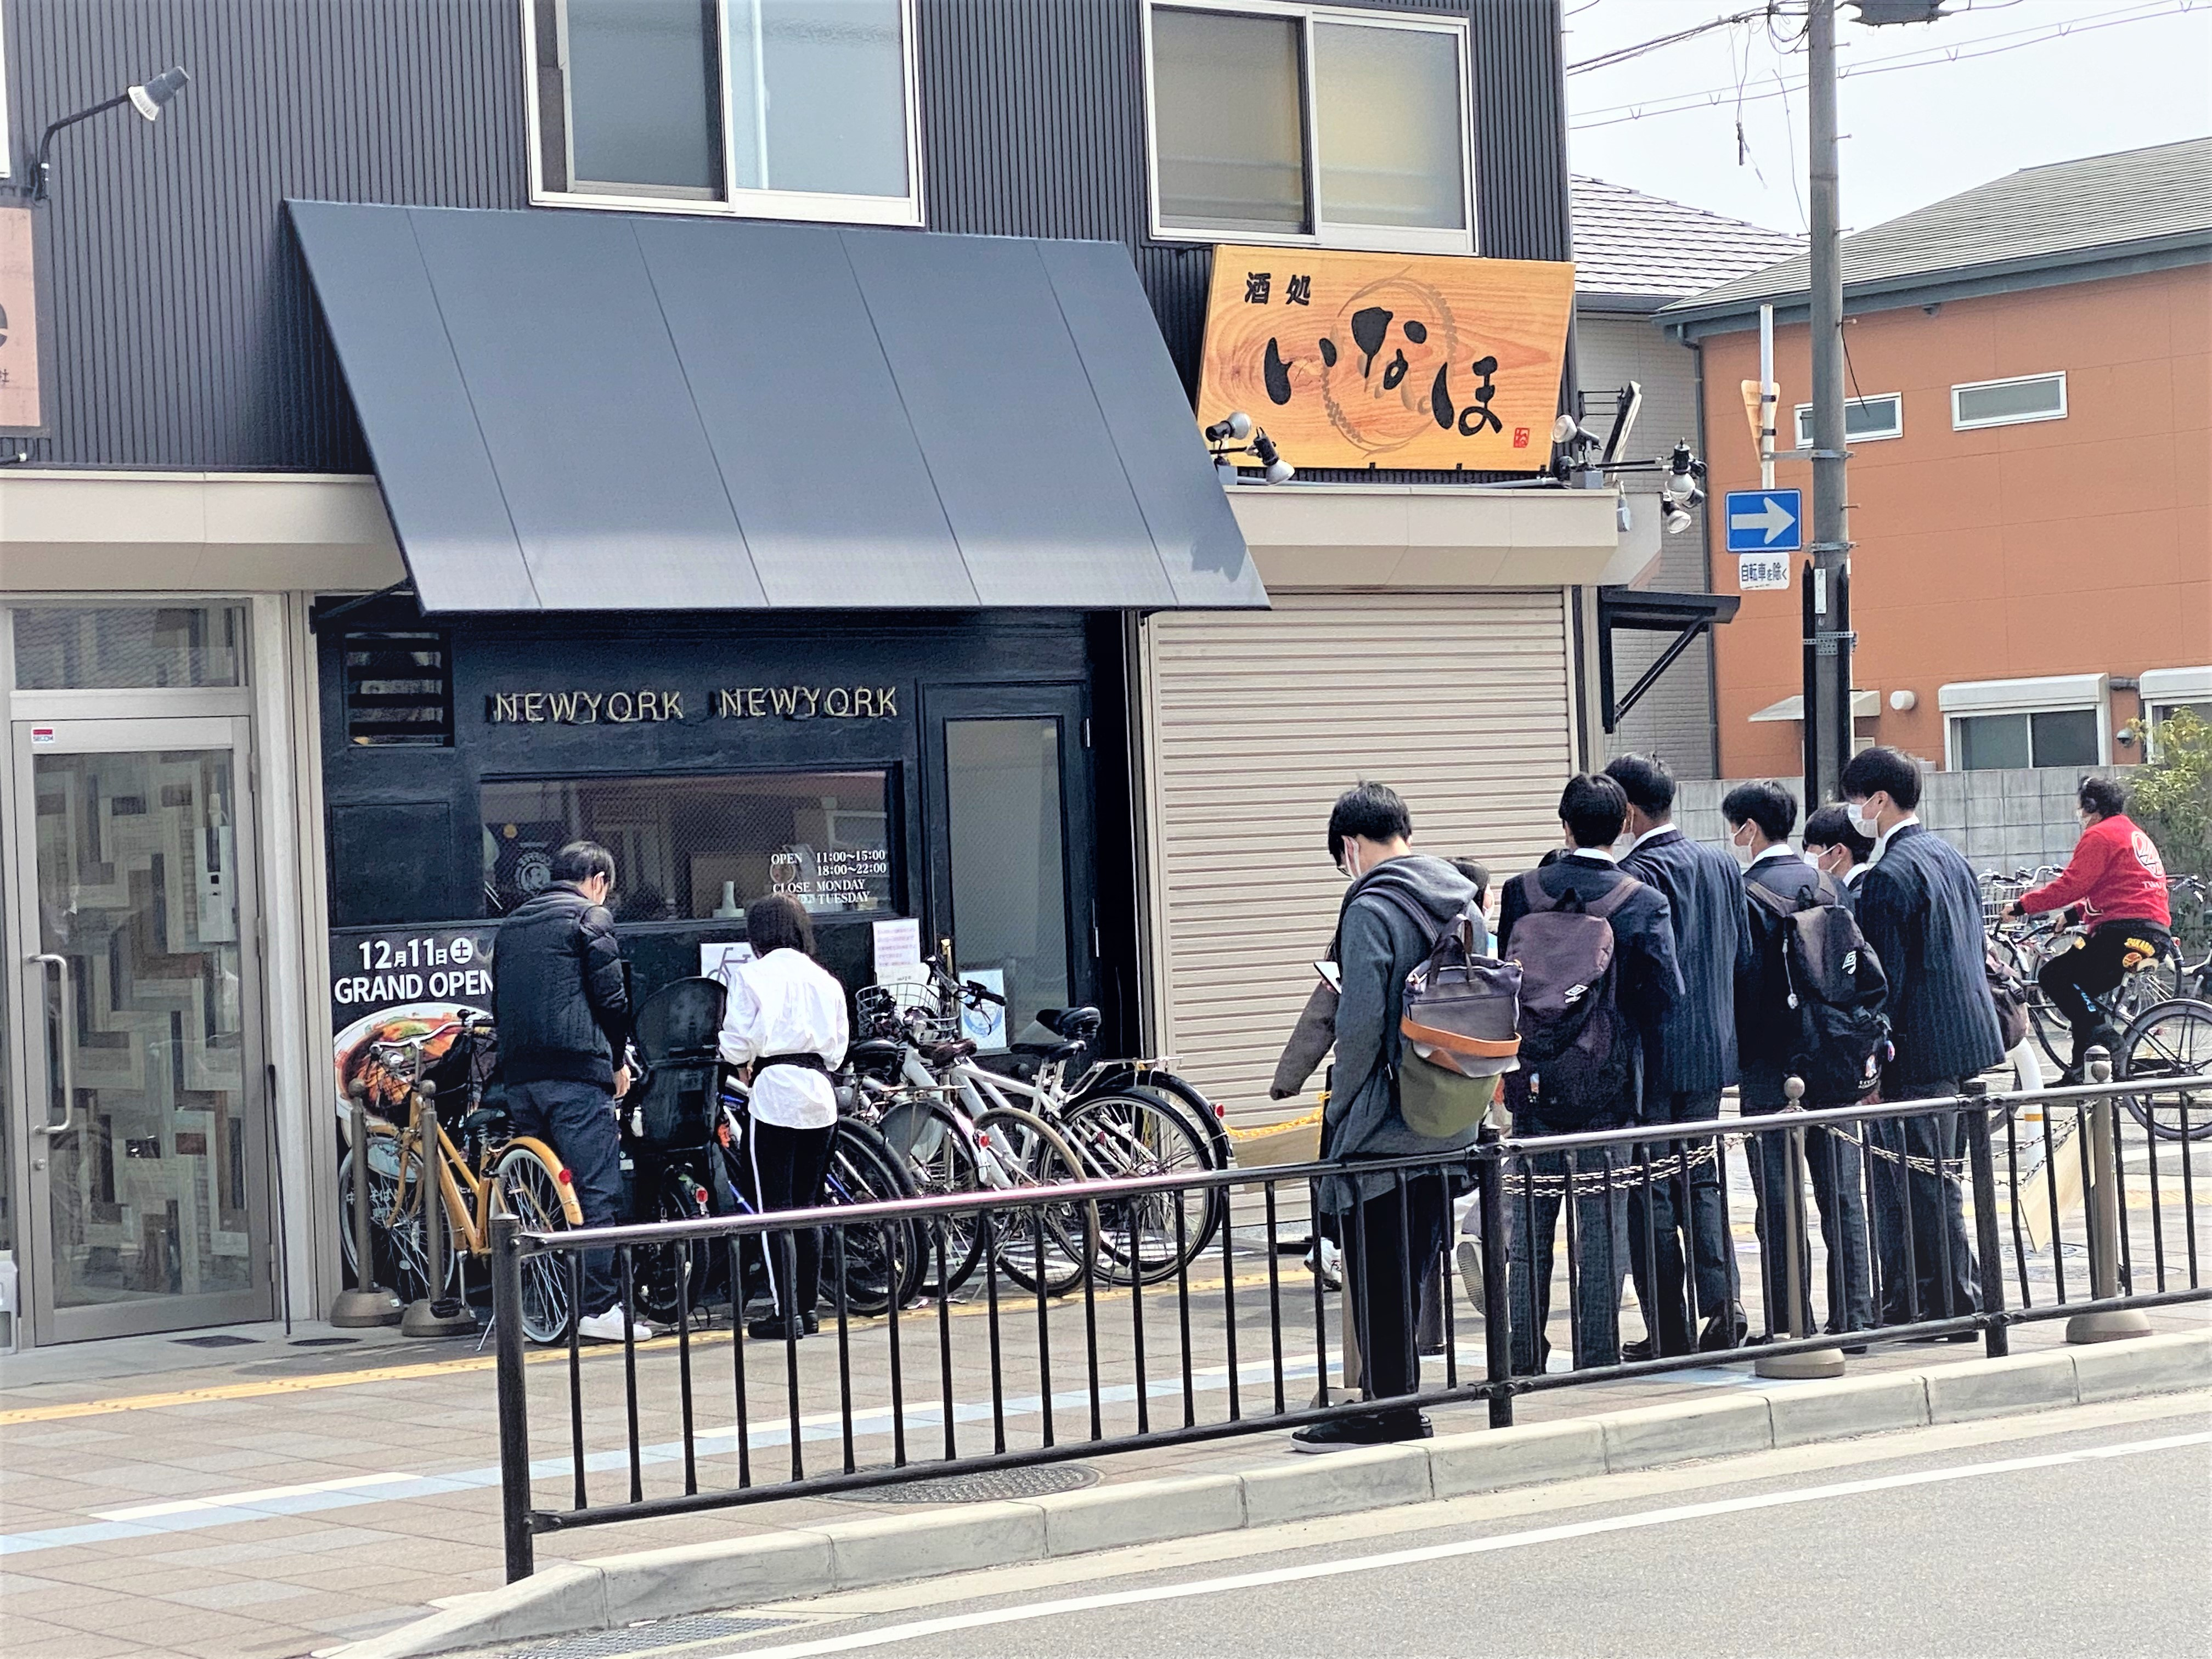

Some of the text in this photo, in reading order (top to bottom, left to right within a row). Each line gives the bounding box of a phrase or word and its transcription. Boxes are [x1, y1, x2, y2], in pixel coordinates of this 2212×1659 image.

[1244, 272, 1311, 307] 酒処
[1263, 306, 1503, 437] いなほ
[1741, 562, 1787, 582] 自転車を除く
[771, 853, 803, 865] OPEN
[772, 879, 866, 893] CLOSE MONDAY
[818, 891, 871, 905] TUESDAY
[334, 973, 424, 1004] GRAND
